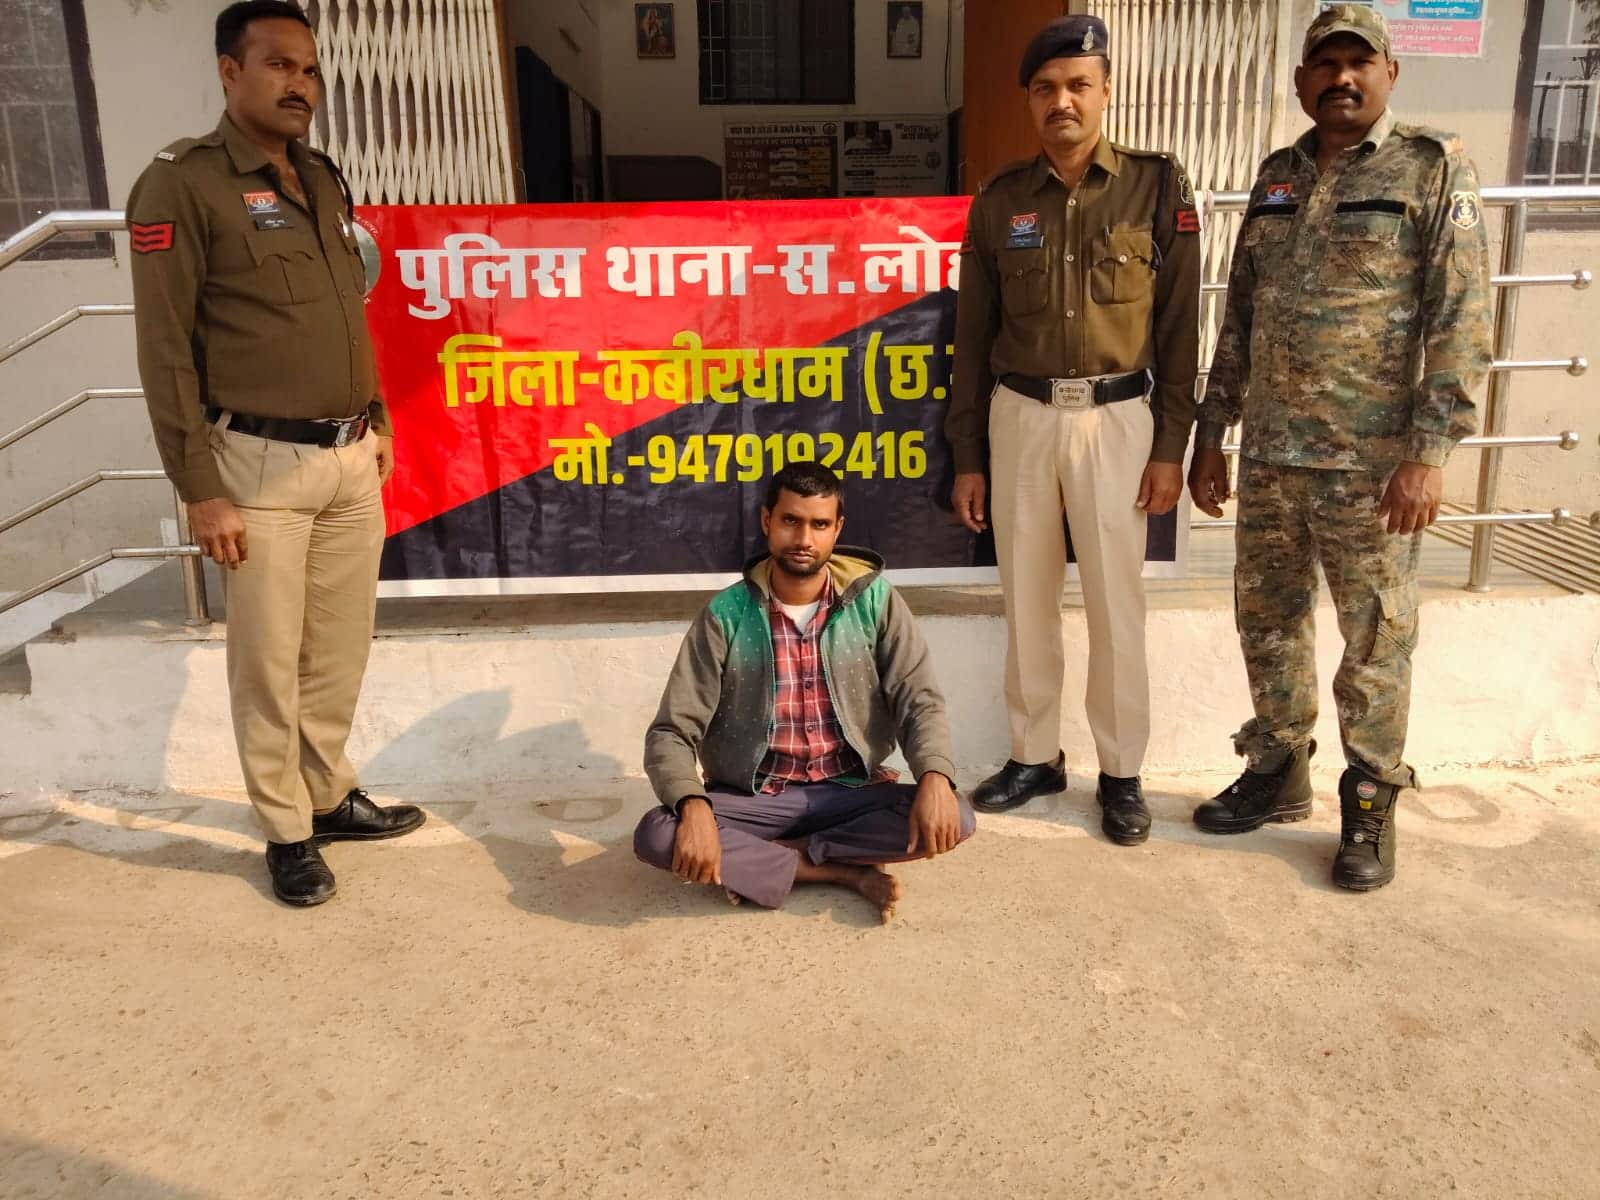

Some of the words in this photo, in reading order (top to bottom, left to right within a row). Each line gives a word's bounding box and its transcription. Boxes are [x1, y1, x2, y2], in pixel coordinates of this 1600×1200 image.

[395, 233, 587, 320] पुलिस
[437, 332, 848, 408] जिला-कबीरधाम
[864, 331, 954, 415] (छ.
